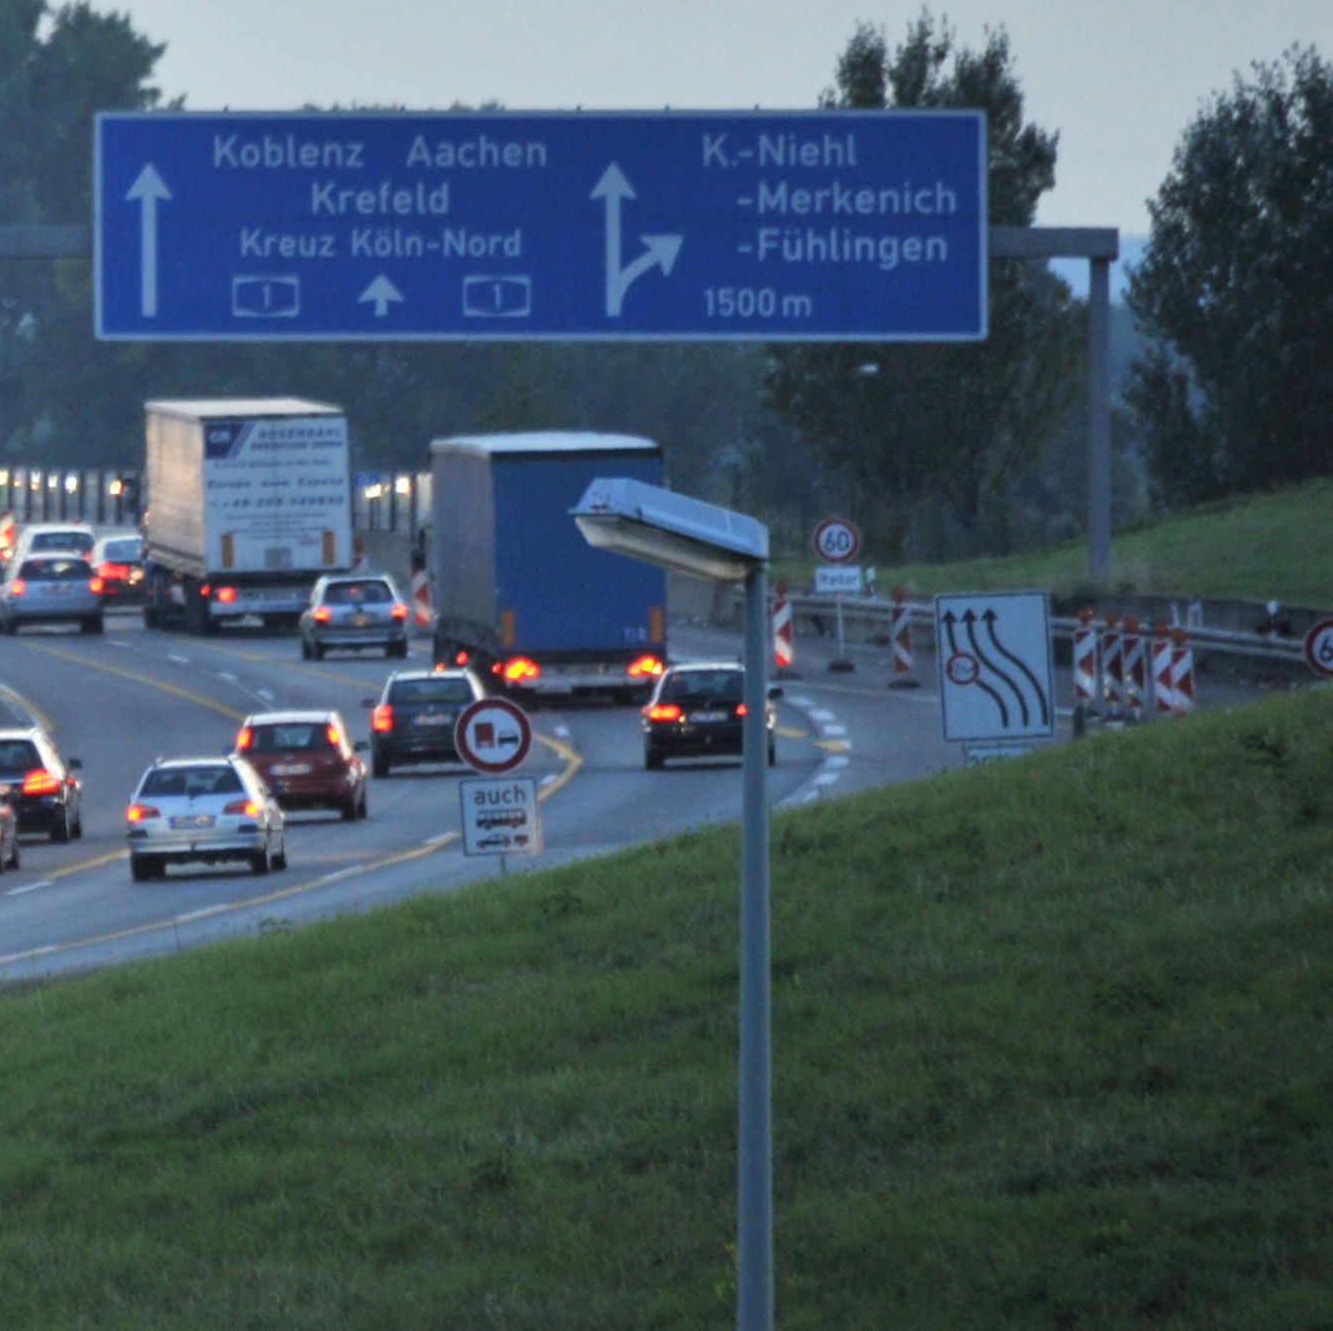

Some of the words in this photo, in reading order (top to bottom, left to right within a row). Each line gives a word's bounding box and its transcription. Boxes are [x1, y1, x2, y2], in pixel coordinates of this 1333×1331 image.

[213, 135, 364, 168] Koblenz
[406, 135, 547, 168] Aachen
[702, 133, 858, 168] K.-Niehl
[311, 182, 450, 215] Krefeld
[737, 181, 958, 215] -Merkenich
[240, 228, 334, 258] Kreuz
[351, 228, 522, 258] Köln-Nord
[737, 228, 948, 270] -Fühlingen
[261, 284, 272, 310] 1
[492, 284, 503, 310] 1
[704, 288, 776, 318] 1500
[783, 295, 812, 318] m
[824, 530, 850, 552] 60
[1320, 636, 1333, 663] 6
[473, 784, 526, 806] auch
